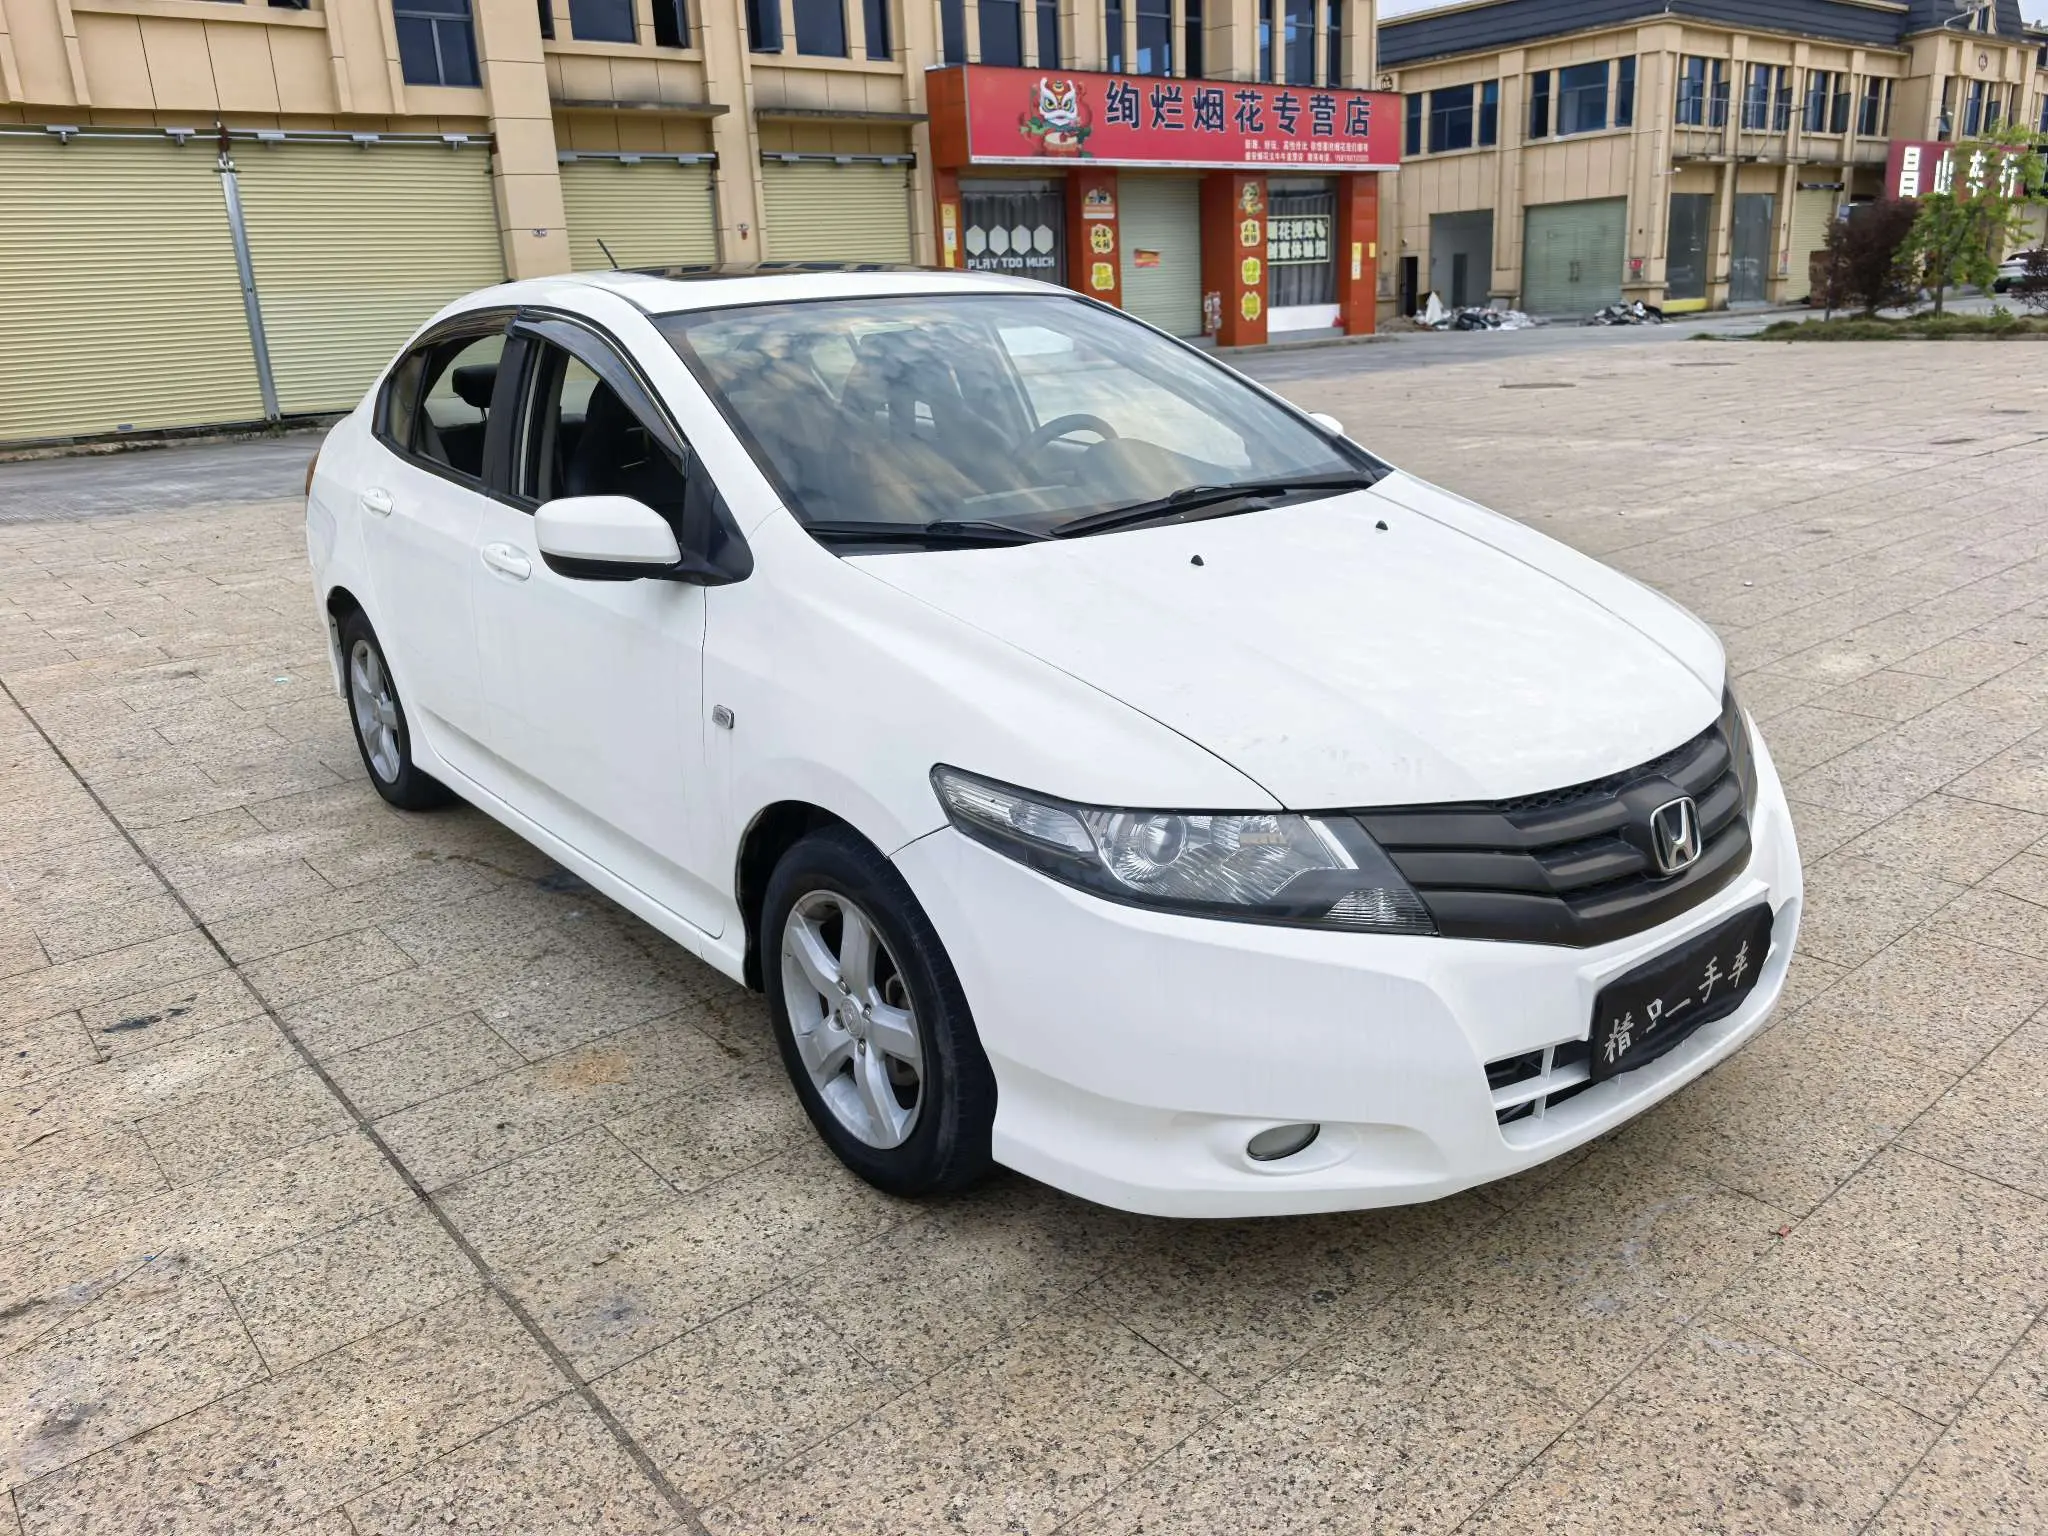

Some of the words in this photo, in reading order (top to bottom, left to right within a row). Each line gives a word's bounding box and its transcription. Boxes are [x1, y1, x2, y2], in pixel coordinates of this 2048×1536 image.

[1105, 79, 1373, 138] 绚烂烟花专营店
[967, 257, 999, 270] PLAY
[1001, 256, 1024, 268] TOO
[1025, 256, 1055, 268] MUCH
